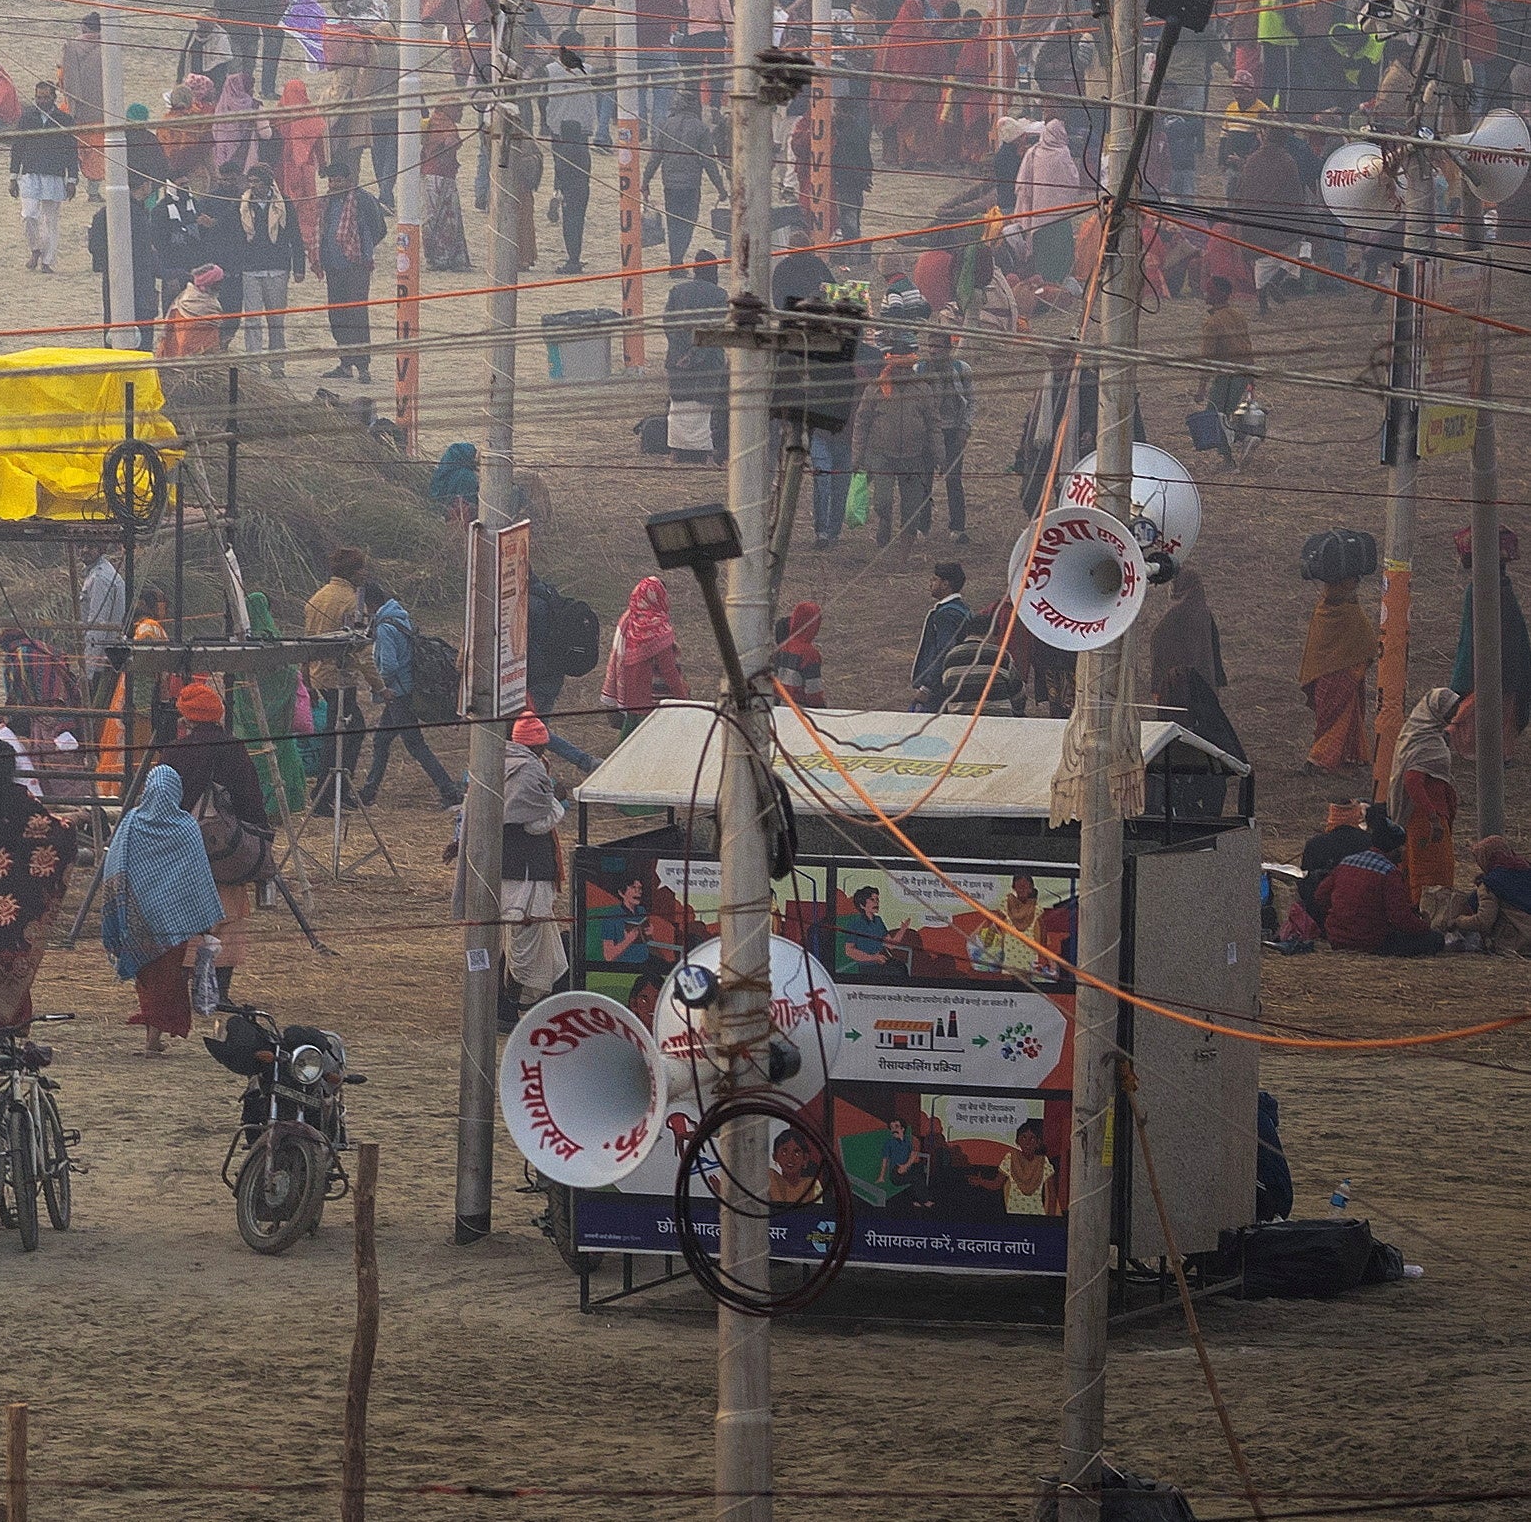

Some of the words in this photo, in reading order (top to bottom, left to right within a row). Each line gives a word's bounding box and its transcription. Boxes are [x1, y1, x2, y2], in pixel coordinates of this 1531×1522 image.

[1025, 519, 1094, 591] आशा
[1030, 596, 1109, 639] प्रयागराज
[529, 1007, 648, 1057] आशा
[878, 1057, 932, 1072] रीसायकलिंग
[933, 1060, 961, 1073] प्रक्रिया
[520, 1059, 585, 1162] प्रयागराज
[864, 1230, 927, 1250] रीसायकल
[930, 1234, 955, 1253] करें,
[957, 1238, 1002, 1254] बदलाव
[1004, 1238, 1036, 1255] लाएं।
